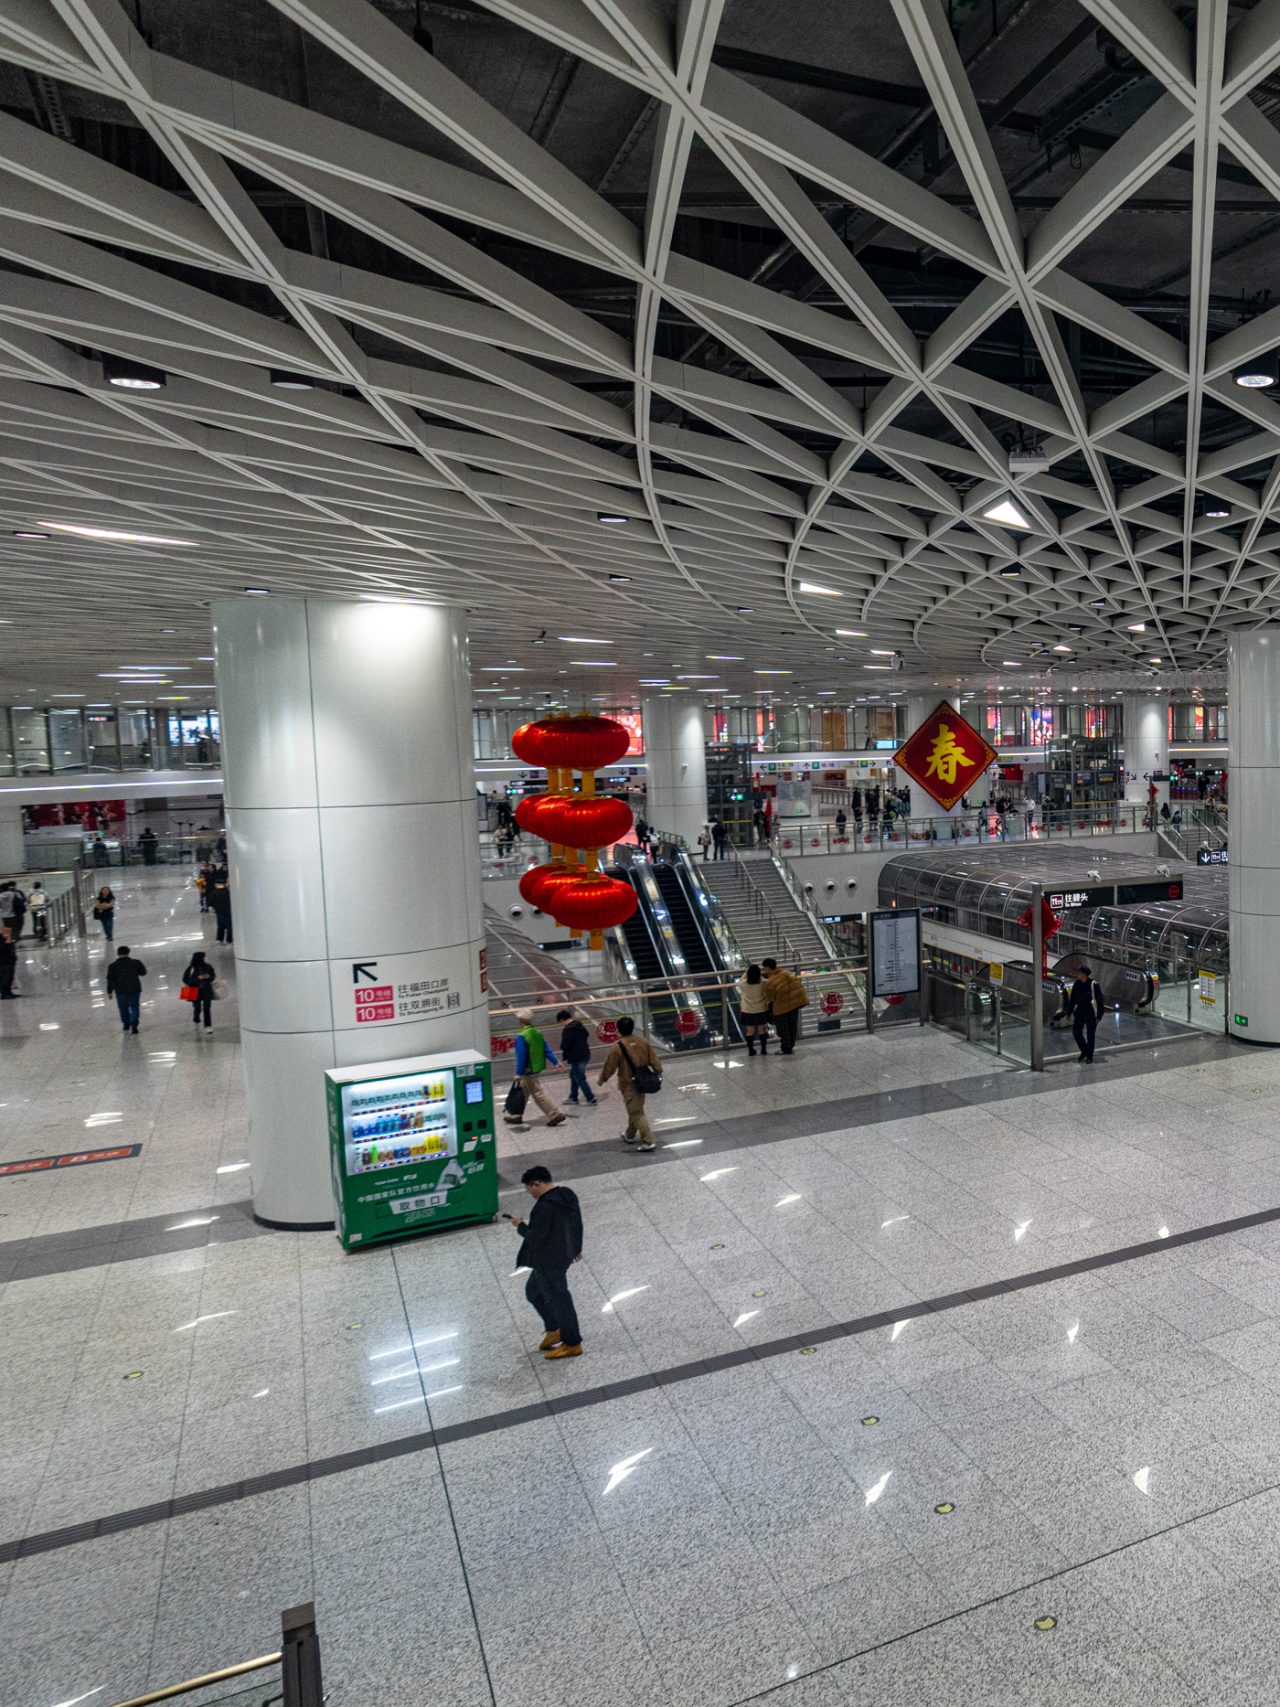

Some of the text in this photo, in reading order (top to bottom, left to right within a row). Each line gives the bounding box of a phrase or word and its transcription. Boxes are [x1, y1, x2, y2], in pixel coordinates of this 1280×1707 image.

[924, 723, 976, 785] 春
[399, 1195, 440, 1211] 取物口
